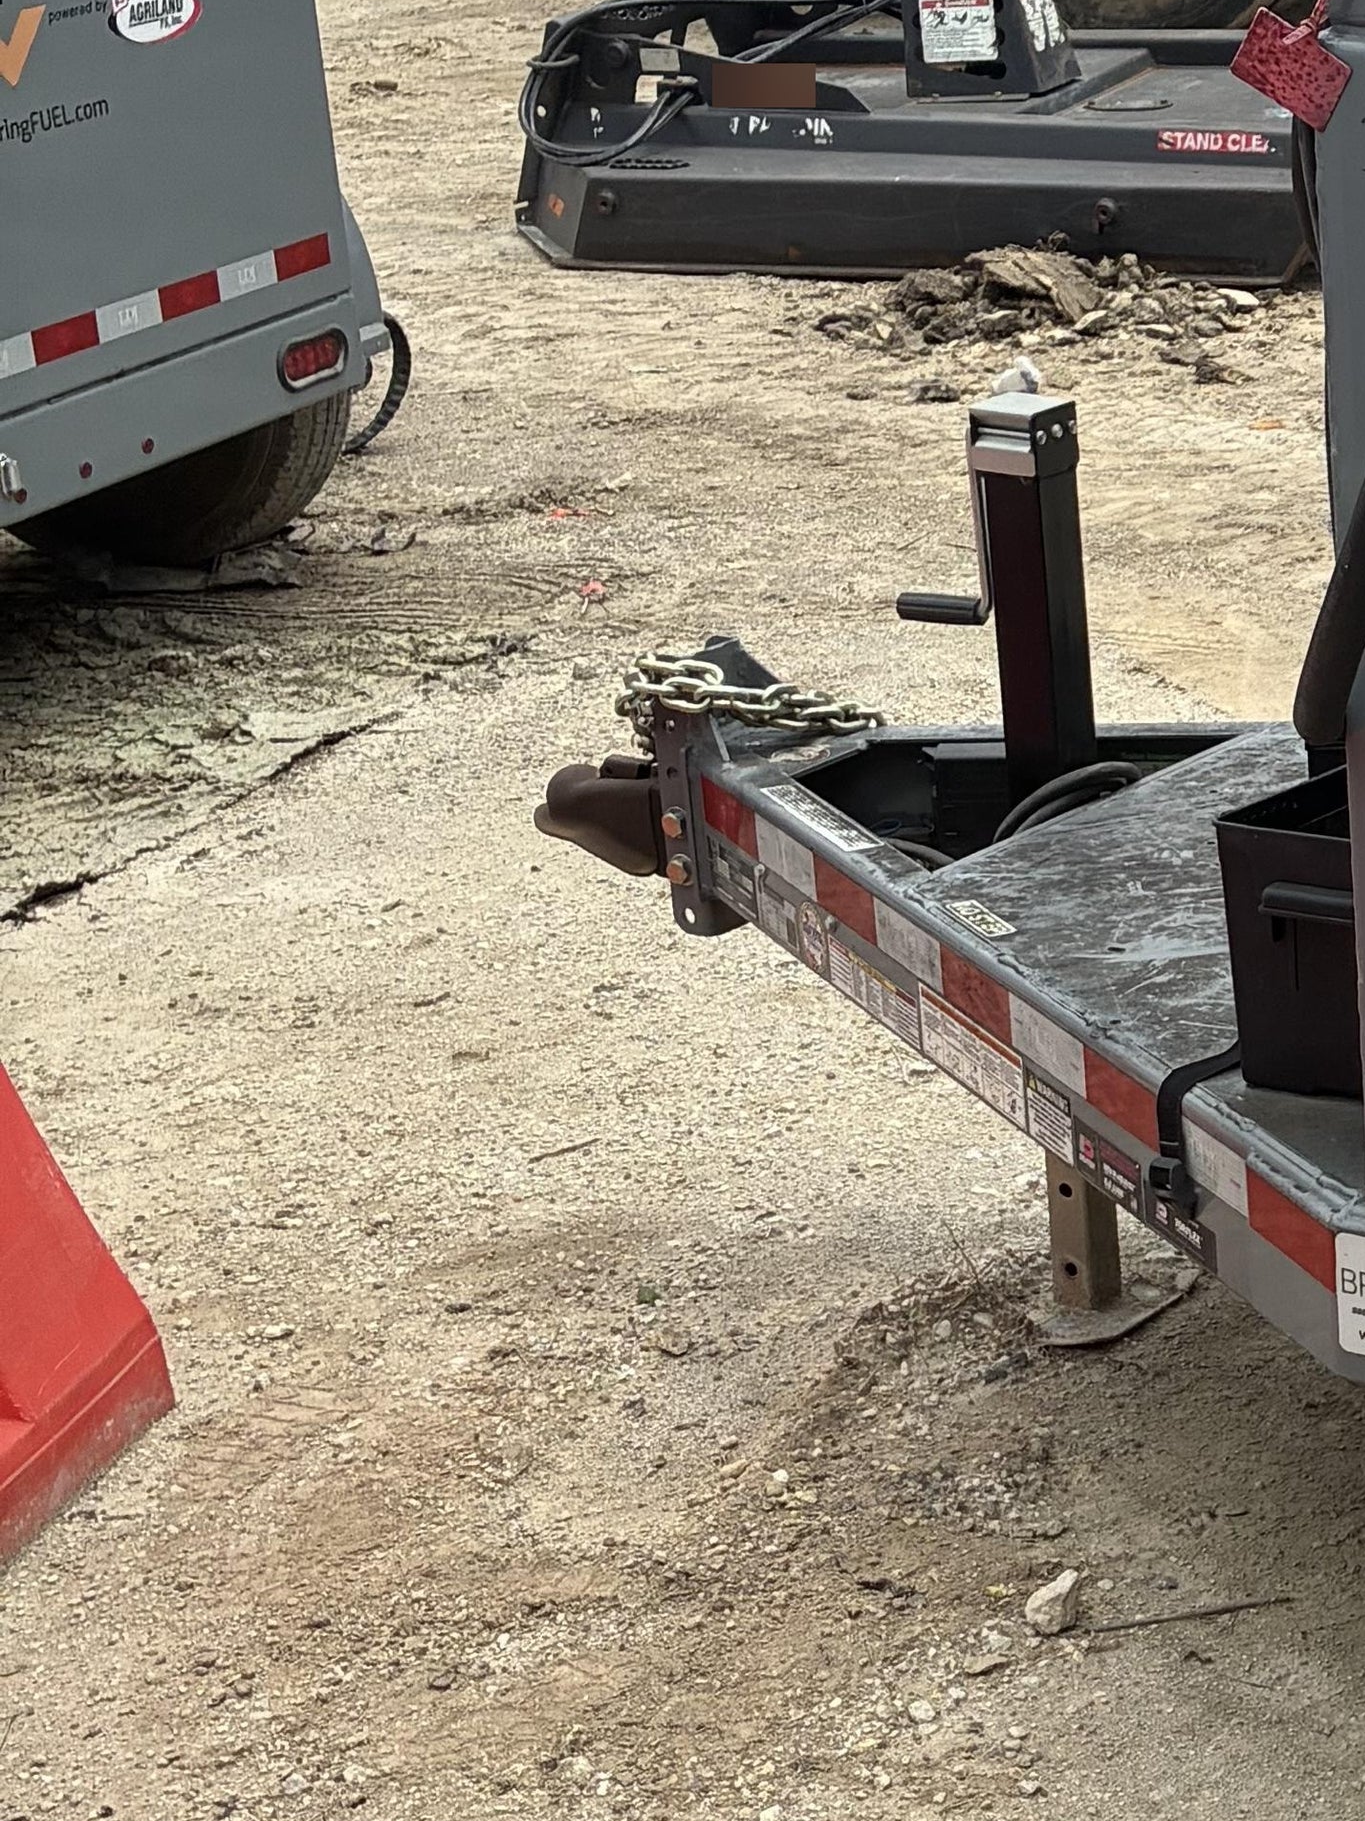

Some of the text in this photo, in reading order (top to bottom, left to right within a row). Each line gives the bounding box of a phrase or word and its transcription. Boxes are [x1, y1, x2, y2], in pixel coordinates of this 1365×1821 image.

[47, 2, 93, 25] powered
[0, 98, 110, 143] ringFUEL.com
[1160, 131, 1223, 151] STAND
